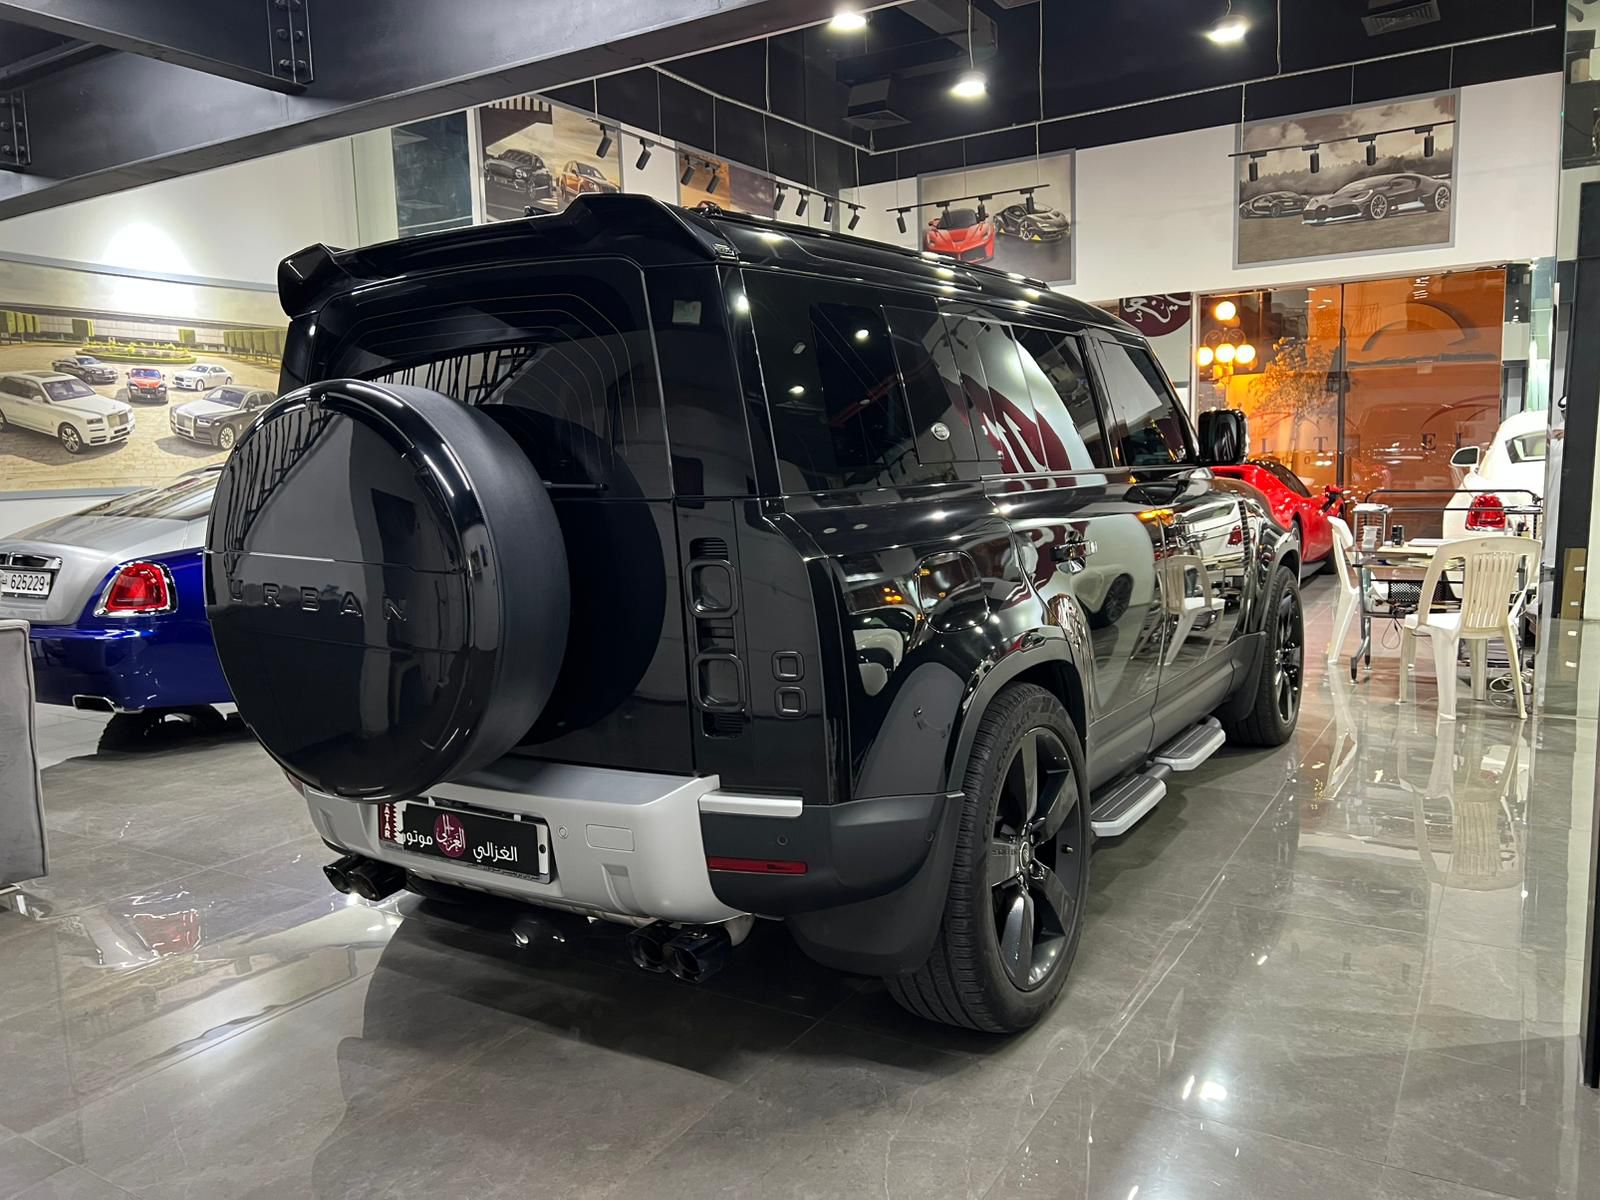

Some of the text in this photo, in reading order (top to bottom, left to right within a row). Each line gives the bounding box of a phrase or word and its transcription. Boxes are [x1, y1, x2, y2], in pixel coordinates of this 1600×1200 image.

[11, 574, 46, 591] 625229
[229, 579, 408, 622] URBAN
[473, 841, 518, 863] الغزالي
